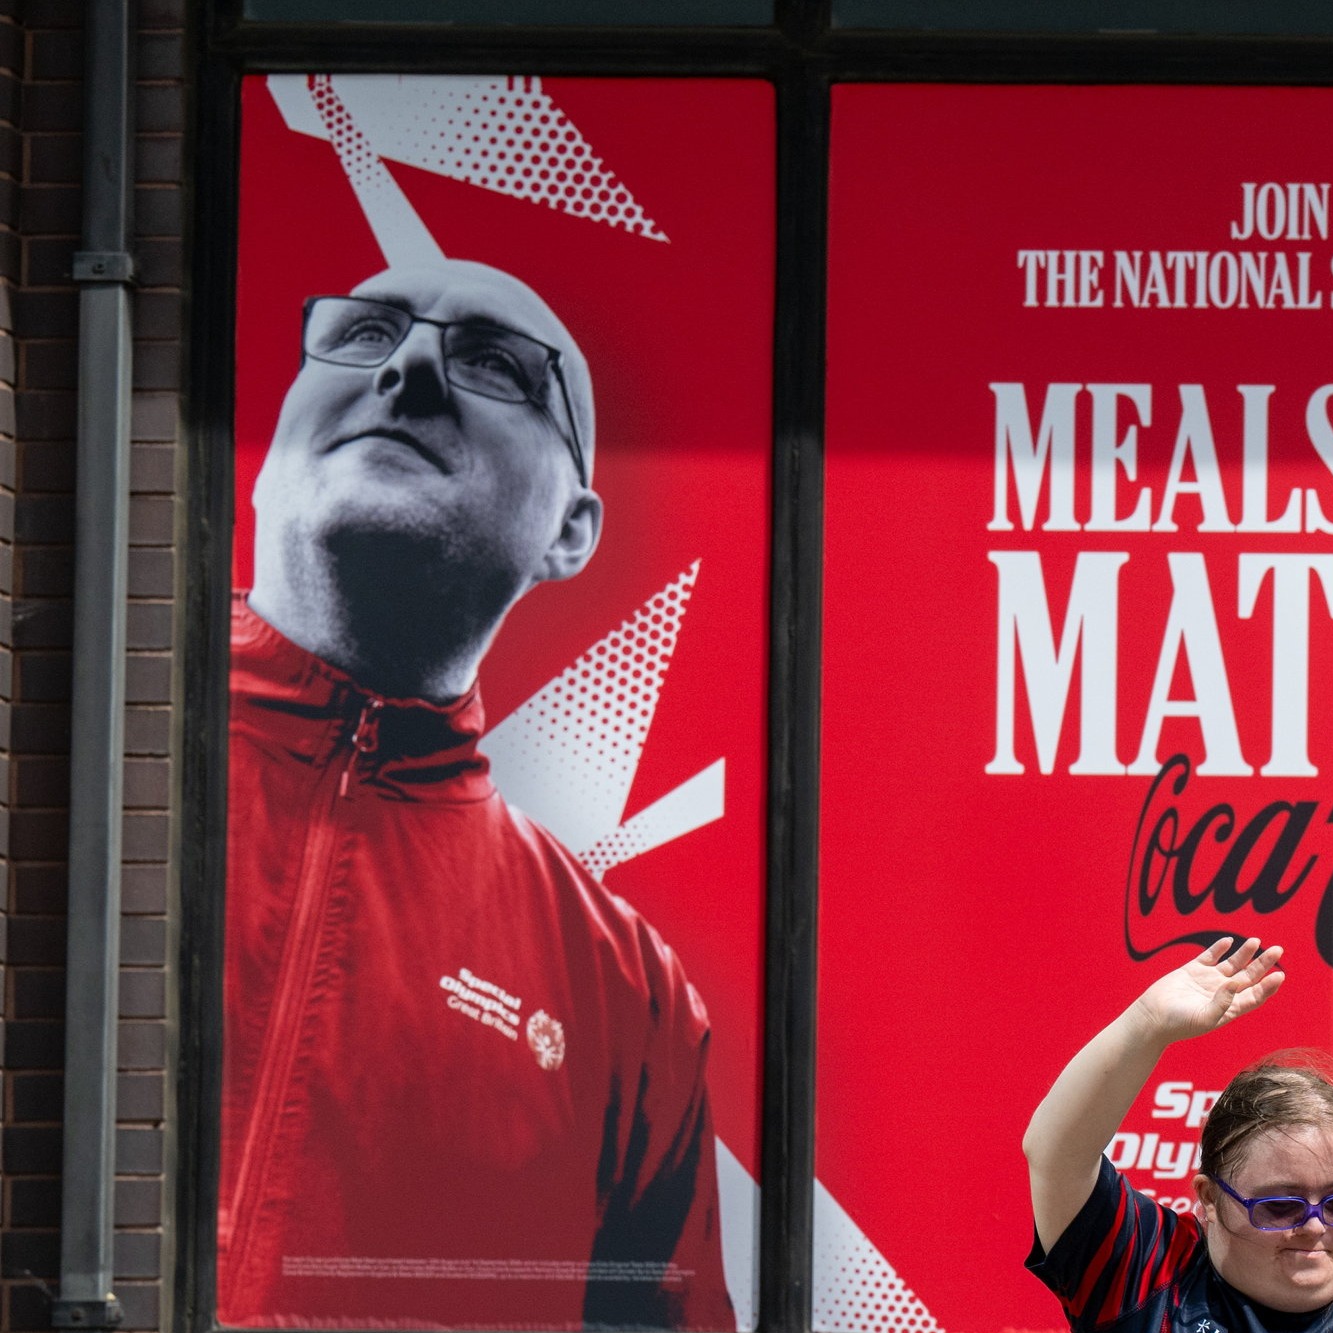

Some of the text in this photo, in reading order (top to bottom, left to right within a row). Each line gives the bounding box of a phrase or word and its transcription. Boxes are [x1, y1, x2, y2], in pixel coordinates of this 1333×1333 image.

[1230, 183, 1329, 240] JOIN
[1017, 250, 1103, 308] THE
[1114, 252, 1322, 309] NATIONAL
